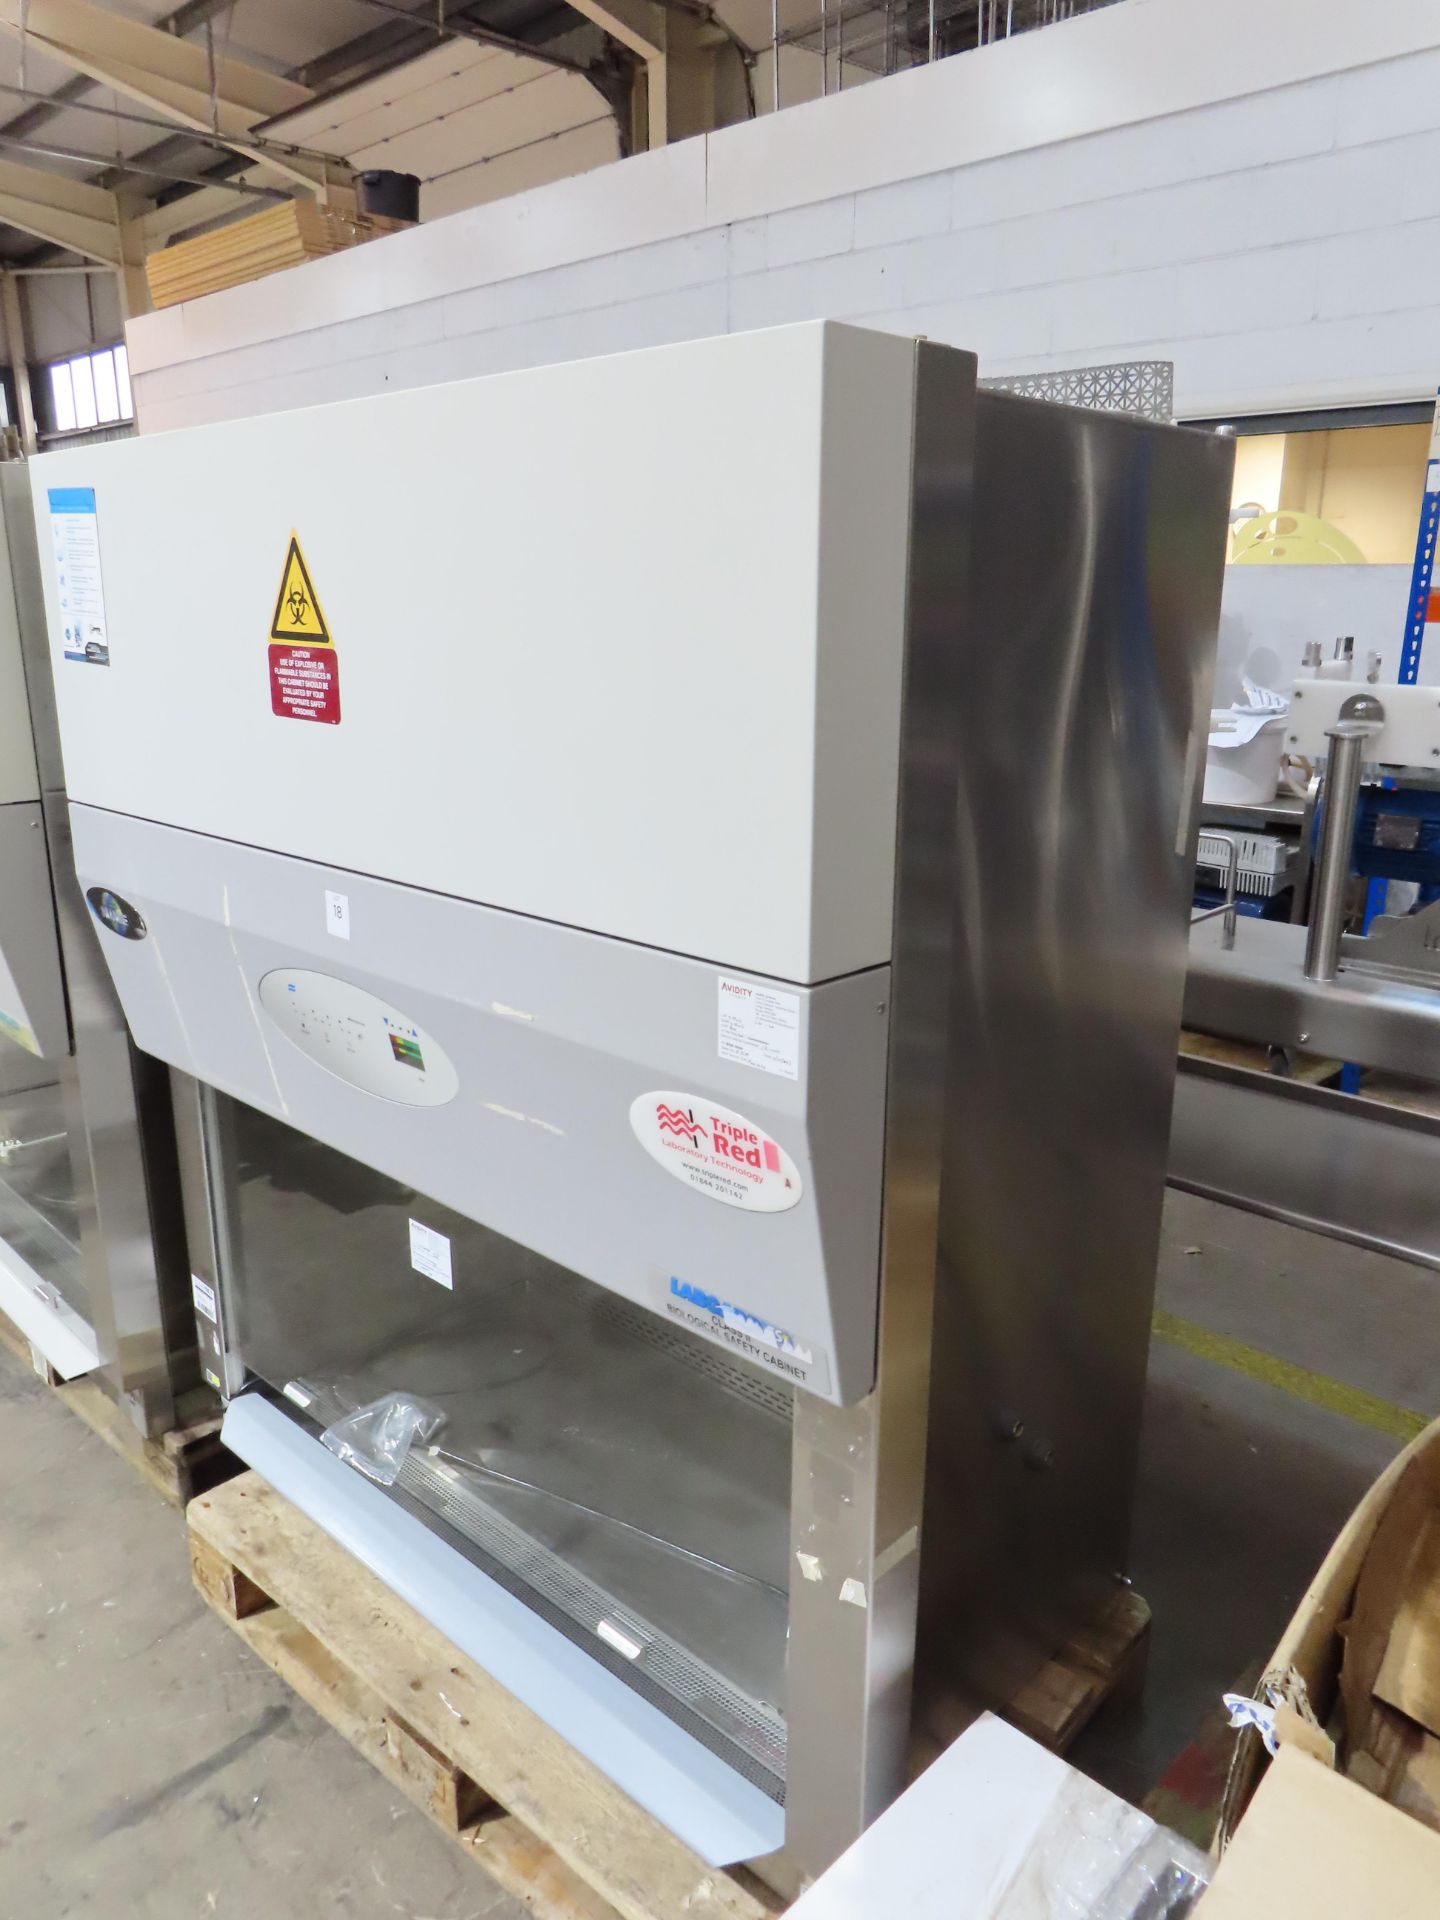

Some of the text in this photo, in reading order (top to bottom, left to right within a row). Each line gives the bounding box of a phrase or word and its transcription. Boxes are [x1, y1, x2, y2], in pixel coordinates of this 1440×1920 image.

[291, 650, 310, 659] CAUTION
[280, 658, 324, 670] USE OF EXPLOSIVE OR
[288, 678, 304, 687] CABINET
[305, 680, 322, 689] SHOULD
[323, 682, 329, 690] BE
[306, 689, 312, 697] BY
[312, 690, 324, 699] YOUR
[310, 700, 326, 709] SAFETY
[333, 904, 342, 919] 18
[721, 982, 752, 997] AVIDITY
[709, 1116, 758, 1145] Triple
[713, 1133, 761, 1168] Red
[662, 1138, 764, 1184] Laboratory Technology
[682, 1162, 748, 1192] www.triplered.com
[690, 1174, 713, 1189] 01844
[666, 1303, 807, 1381] BIOLOGICAL SAFETY CABINET
